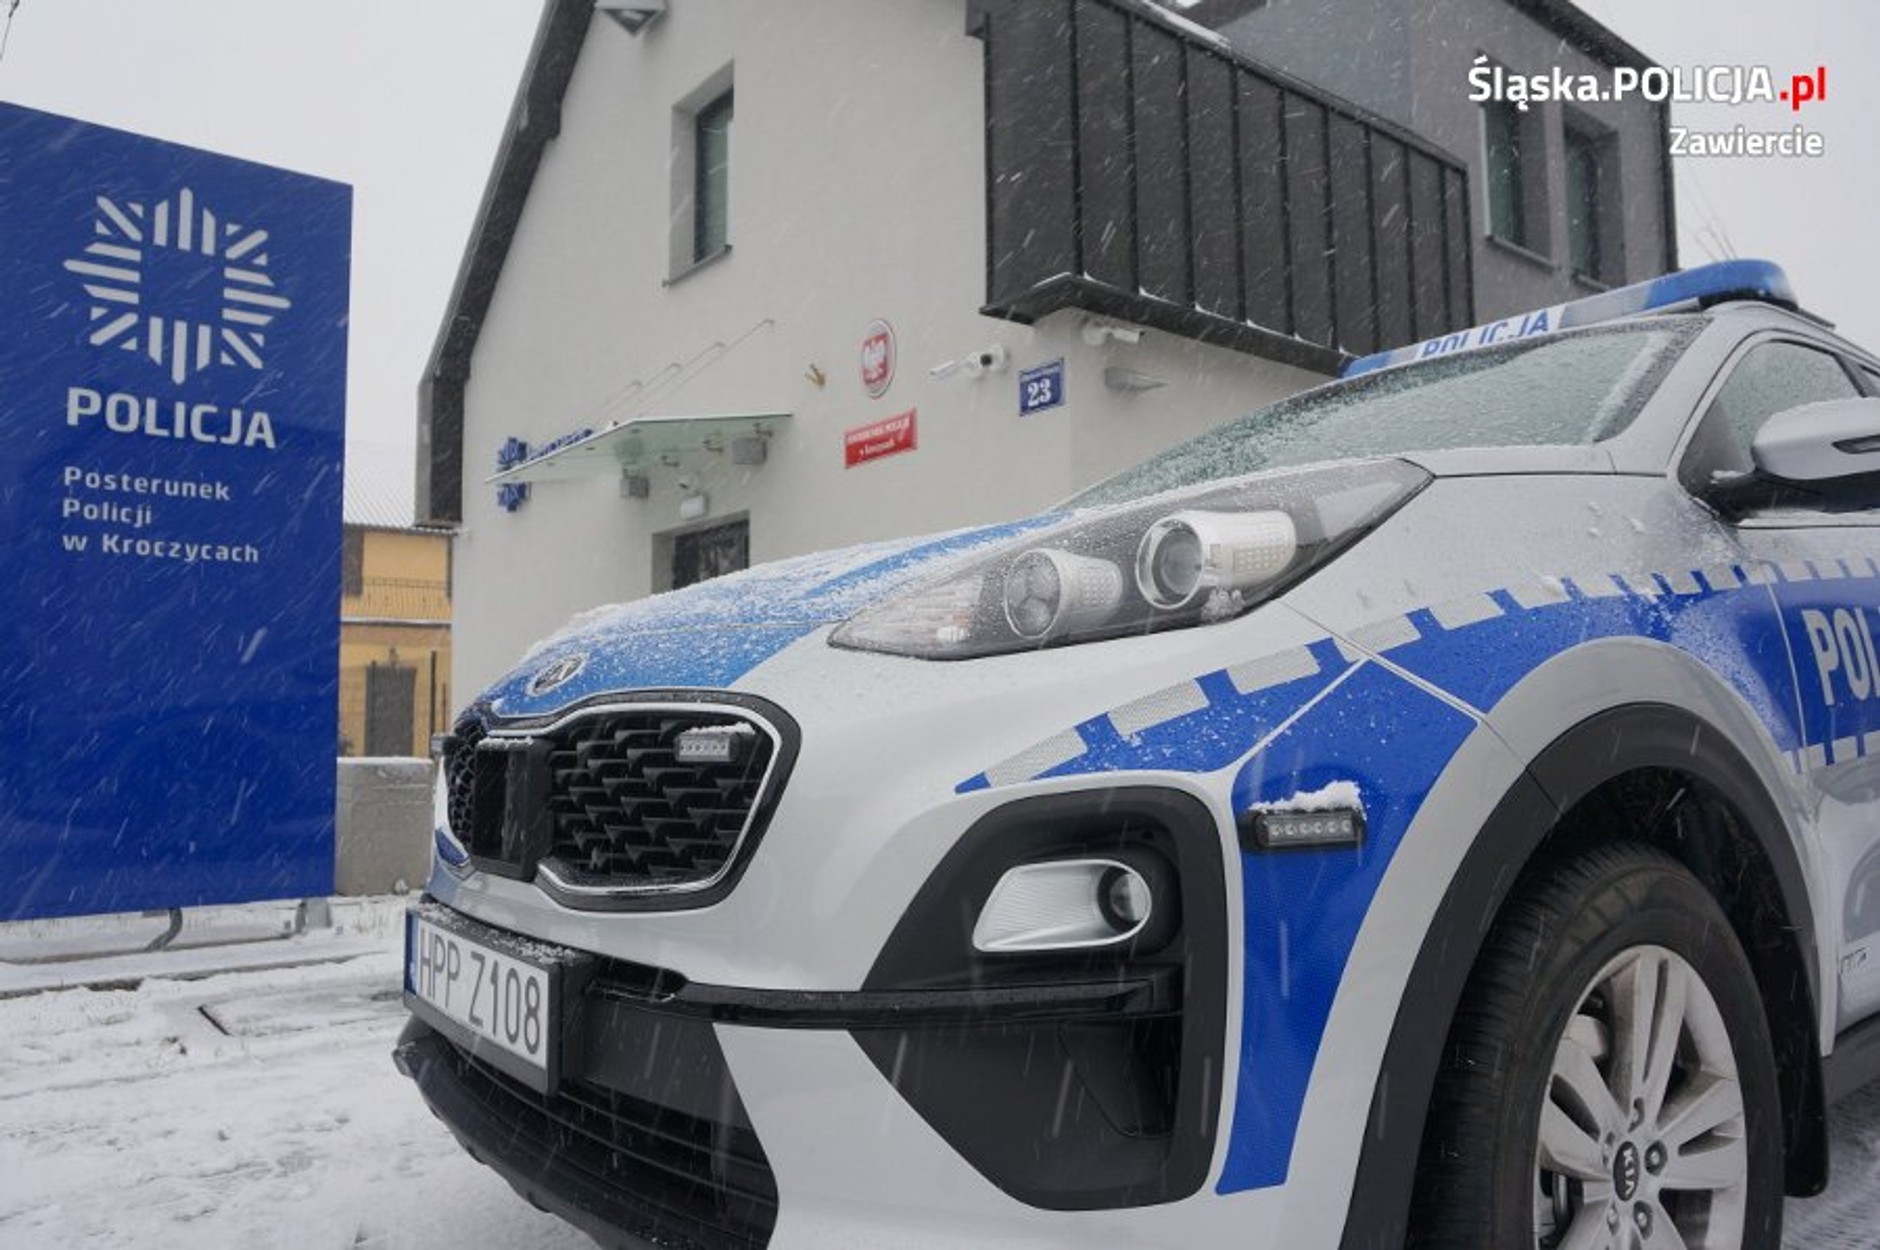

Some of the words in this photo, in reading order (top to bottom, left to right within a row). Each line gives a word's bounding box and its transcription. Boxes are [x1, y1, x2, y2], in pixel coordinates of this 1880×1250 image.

[1027, 378, 1052, 407] 23
[66, 386, 276, 449] POLICJA
[64, 466, 231, 501] Posterunek
[62, 499, 152, 528] Policji
[62, 534, 88, 551] w
[102, 533, 259, 563] Kroczycach
[420, 926, 461, 1009] HPP
[468, 951, 541, 1055] Z108
